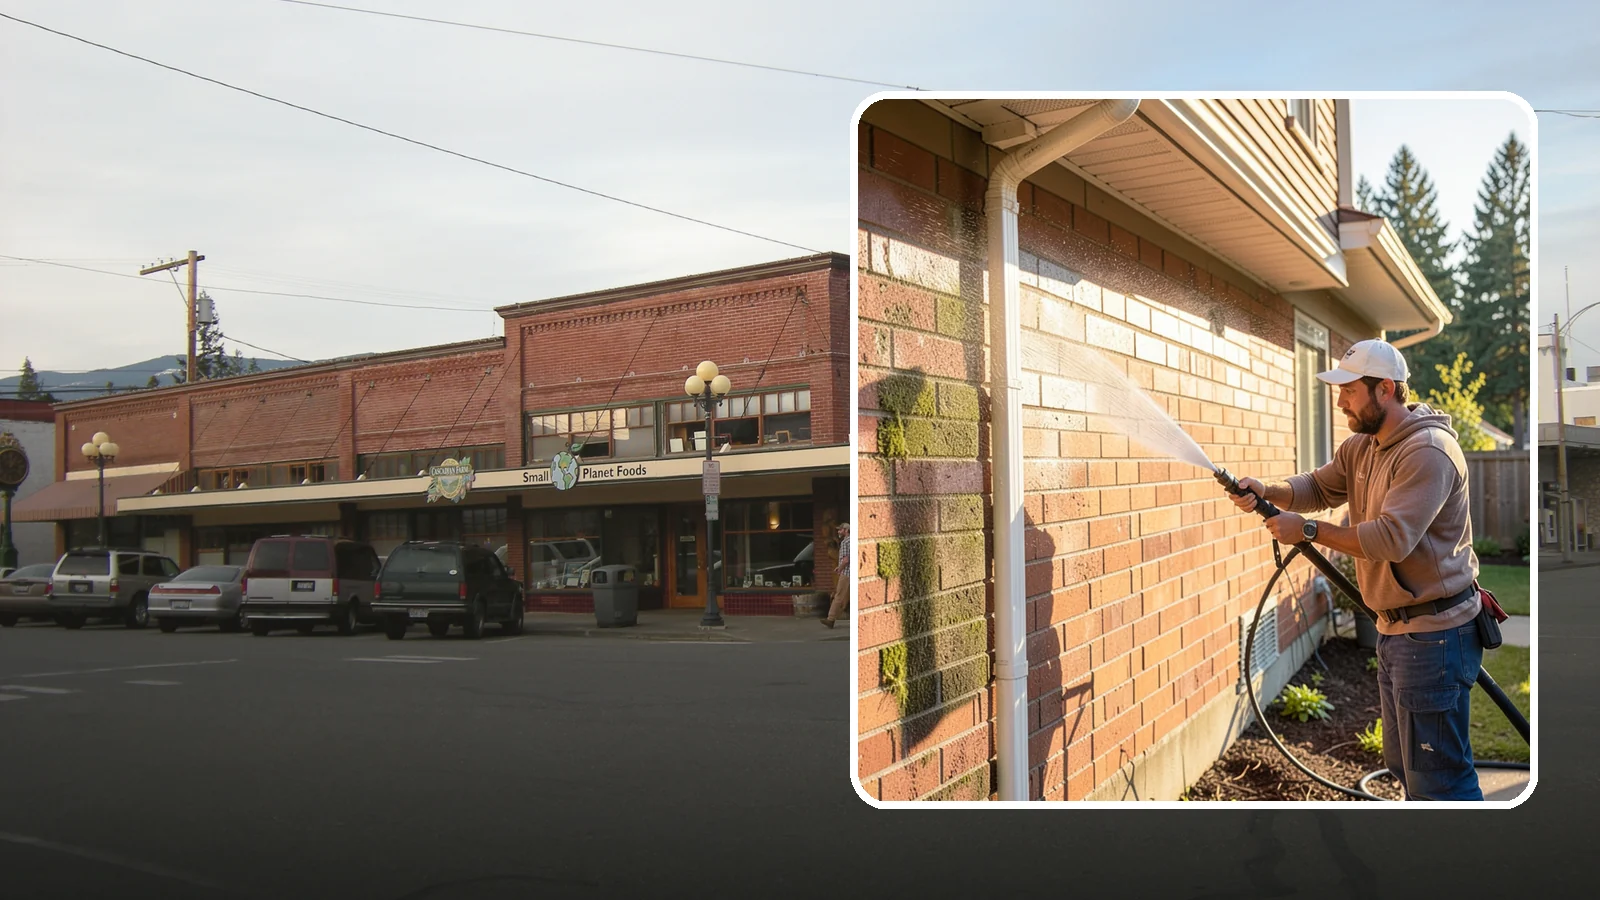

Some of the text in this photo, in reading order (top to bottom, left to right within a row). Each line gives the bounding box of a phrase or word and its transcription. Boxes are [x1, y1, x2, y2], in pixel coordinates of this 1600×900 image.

[523, 464, 647, 483] Small Planet Foods
